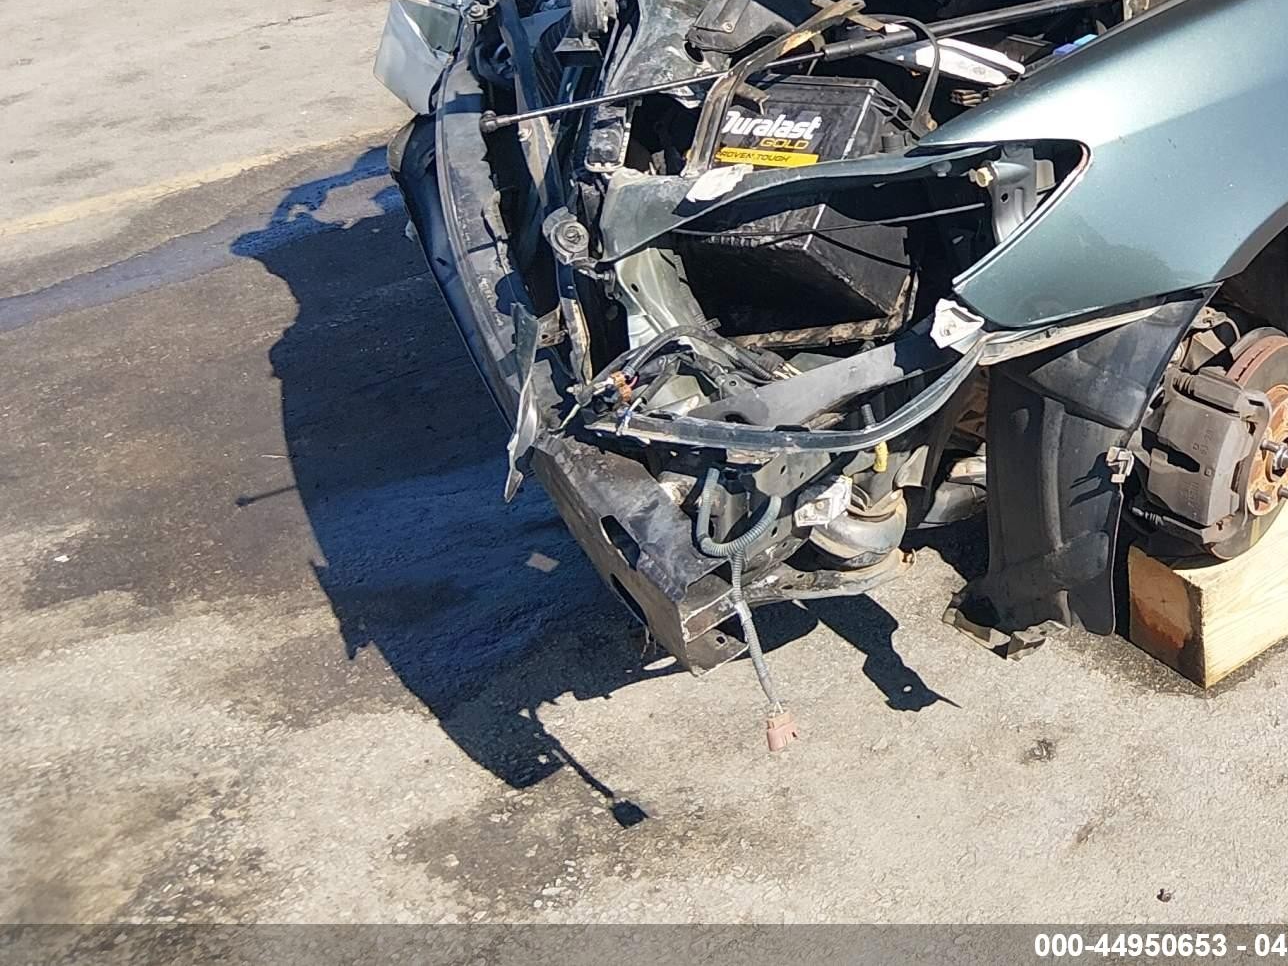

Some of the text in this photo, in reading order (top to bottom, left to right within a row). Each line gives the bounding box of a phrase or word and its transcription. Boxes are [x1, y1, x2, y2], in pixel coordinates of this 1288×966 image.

[760, 137, 809, 150] GOLD
[718, 150, 792, 162] ROVEN TOUGH
